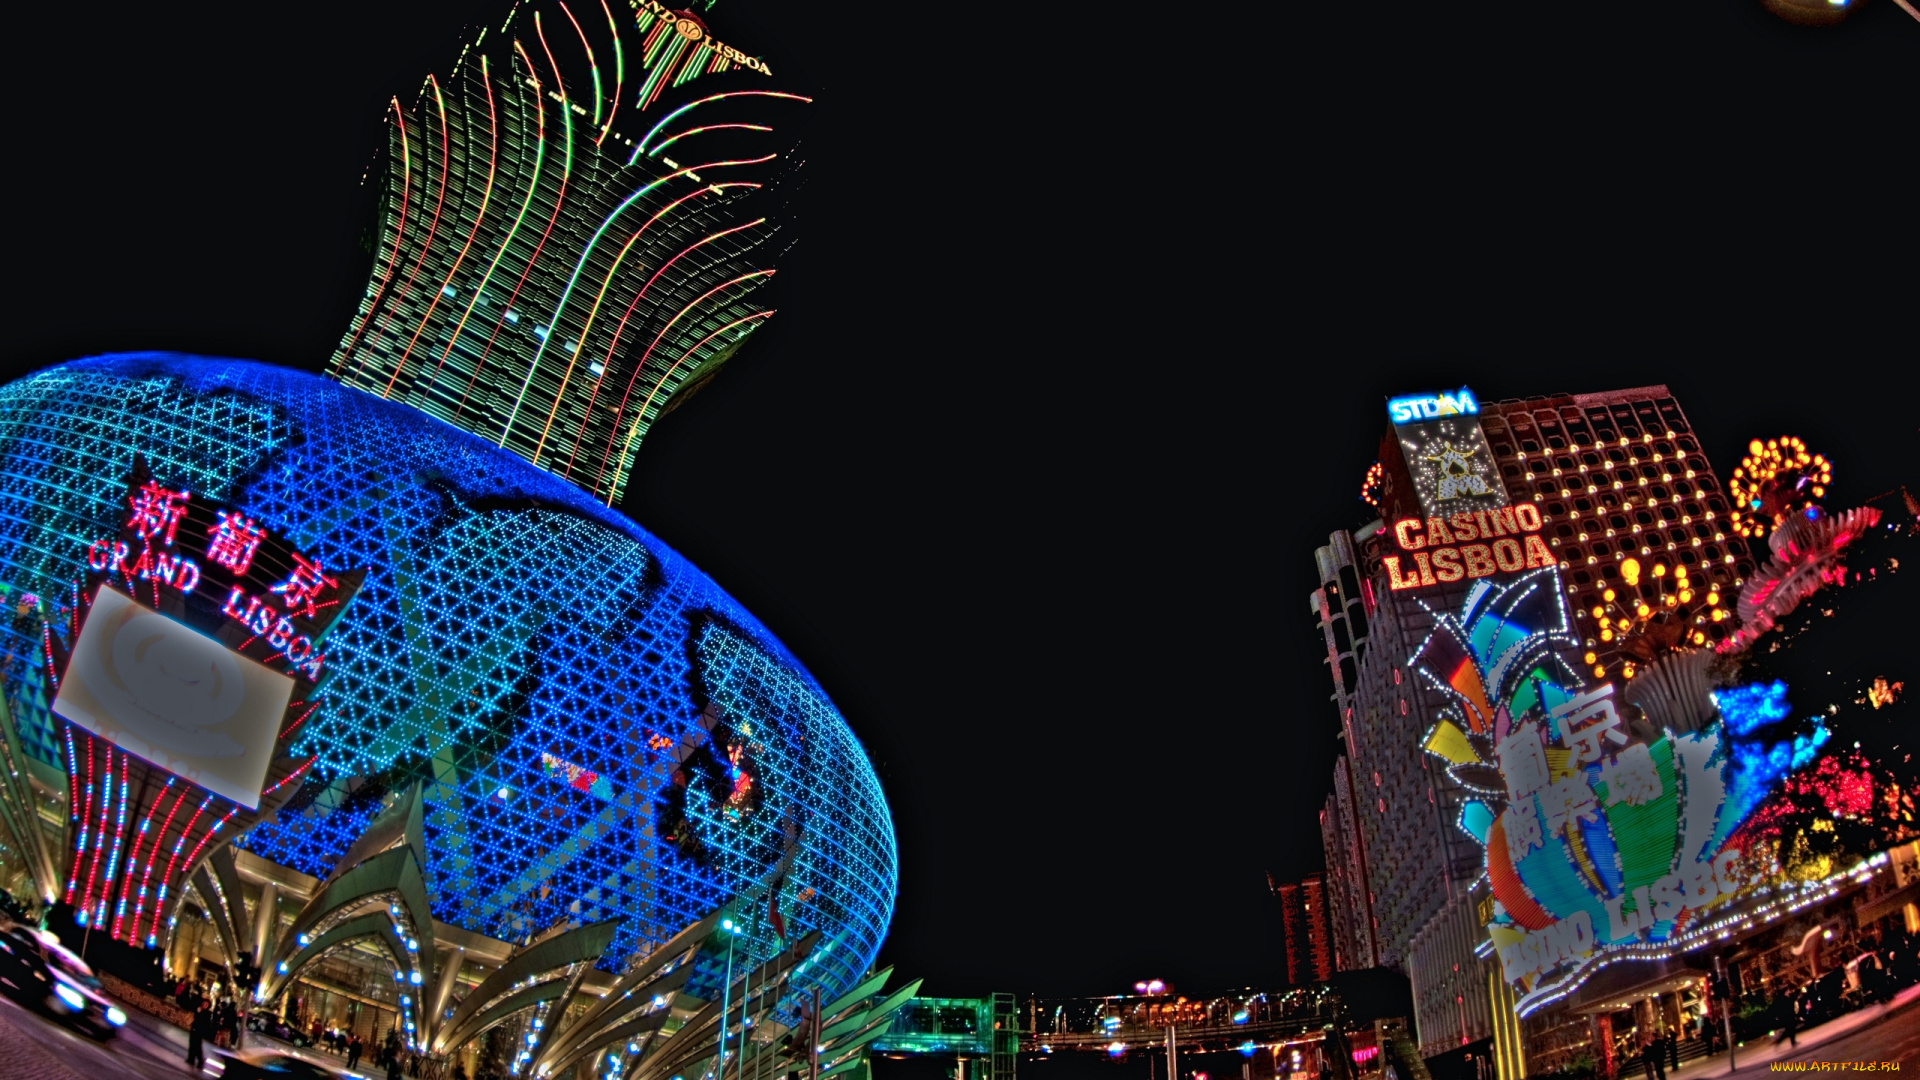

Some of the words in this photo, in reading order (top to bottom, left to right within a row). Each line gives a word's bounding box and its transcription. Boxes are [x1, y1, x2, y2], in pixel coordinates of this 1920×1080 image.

[702, 35, 772, 76] LISBOA
[127, 480, 338, 618] 新葡京
[1394, 503, 1542, 550] CASINO
[1382, 534, 1557, 590] LISBOA
[88, 540, 199, 593] GRAND
[223, 585, 325, 681] LISBOA
